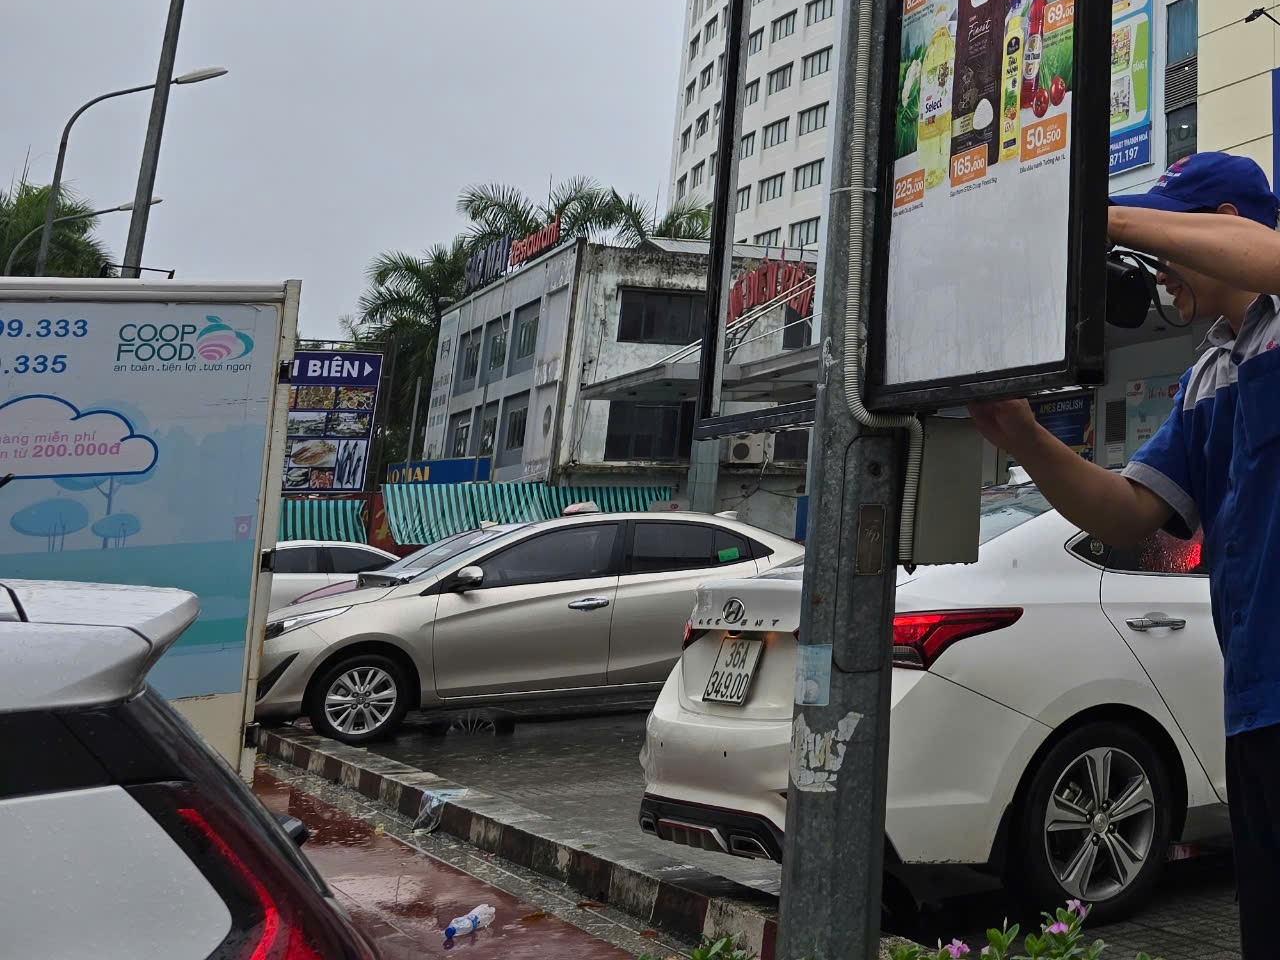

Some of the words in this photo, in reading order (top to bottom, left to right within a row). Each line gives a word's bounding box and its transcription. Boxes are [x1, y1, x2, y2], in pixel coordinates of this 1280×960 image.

[925, 97, 943, 114] Select
[1026, 125, 1061, 148] 50.500
[953, 156, 985, 176] 165.000
[0, 319, 88, 338] 9.333
[116, 343, 195, 362] FOOD
[113, 363, 127, 372] an
[130, 362, 154, 372] toàn
[185, 362, 197, 373] lợi
[226, 363, 252, 374] ngon
[307, 355, 360, 378] BIÊN
[34, 430, 69, 443] miễn
[74, 429, 97, 444] phí
[14, 447, 28, 459] từ
[31, 442, 122, 458] 200.000đ
[725, 641, 751, 670] 36A
[706, 670, 750, 700] 349.00
